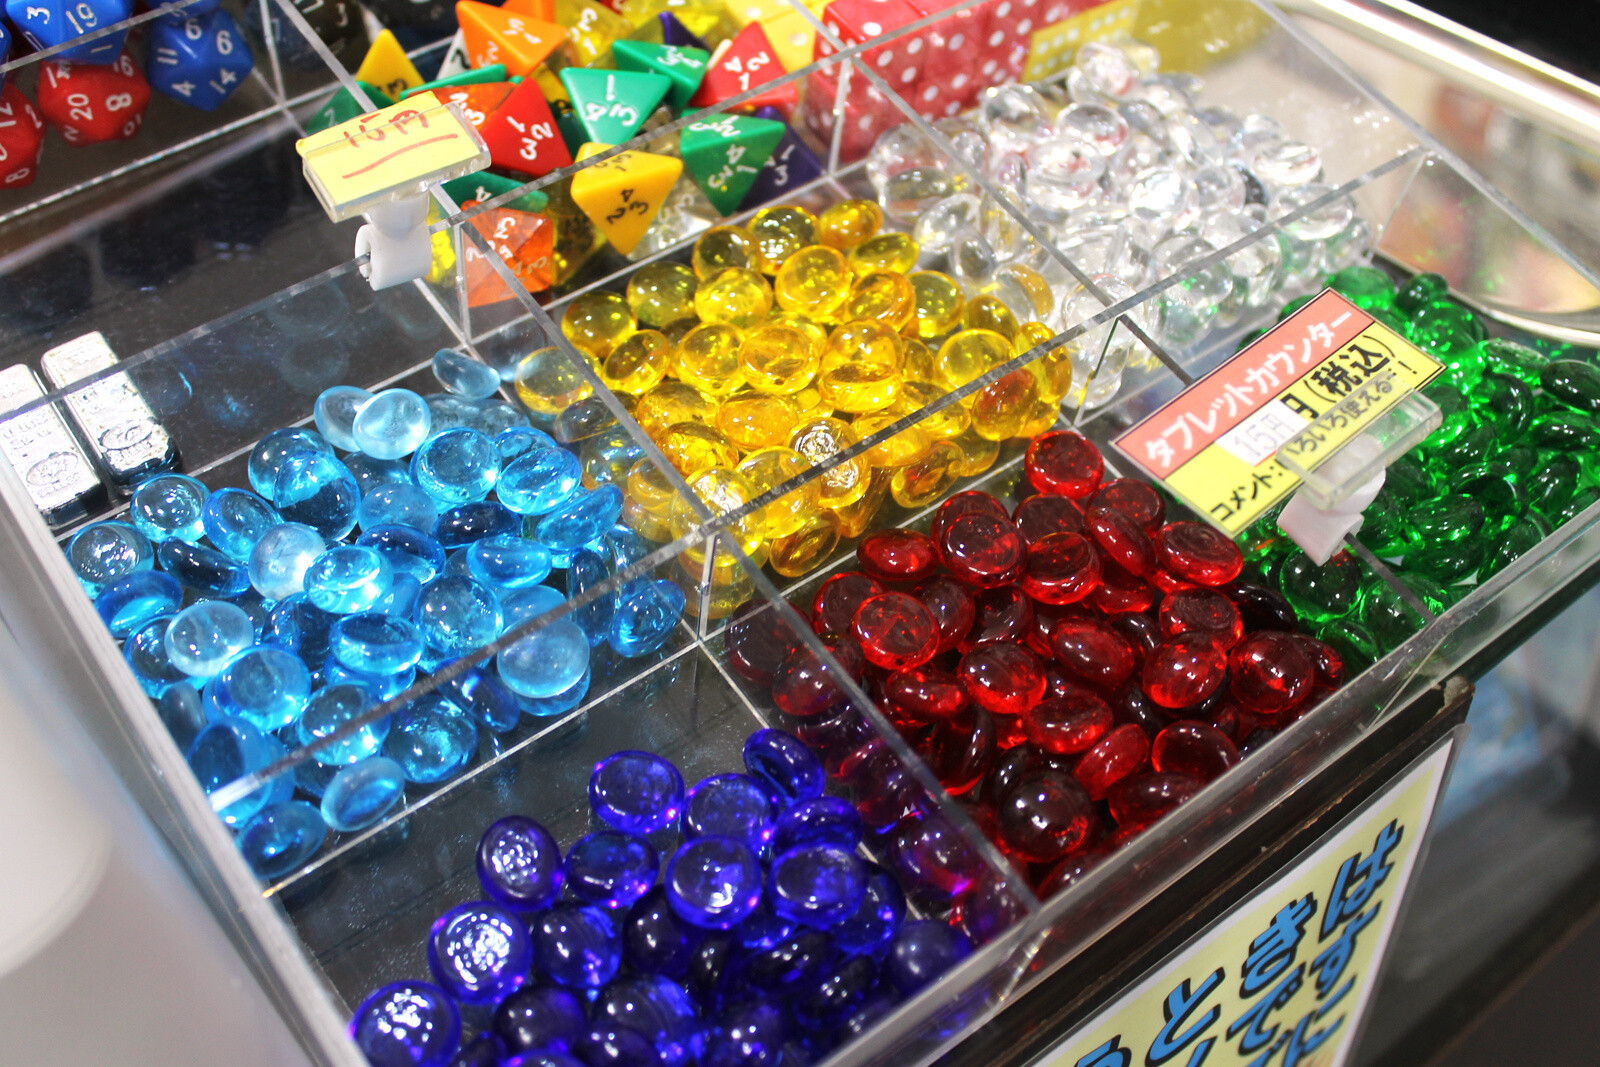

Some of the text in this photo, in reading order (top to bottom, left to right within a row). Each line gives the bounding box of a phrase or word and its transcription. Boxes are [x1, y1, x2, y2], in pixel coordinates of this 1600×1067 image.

[67, 93, 93, 120] 20
[106, 93, 132, 111] 8
[1145, 311, 1352, 468] タブレットカウンター
